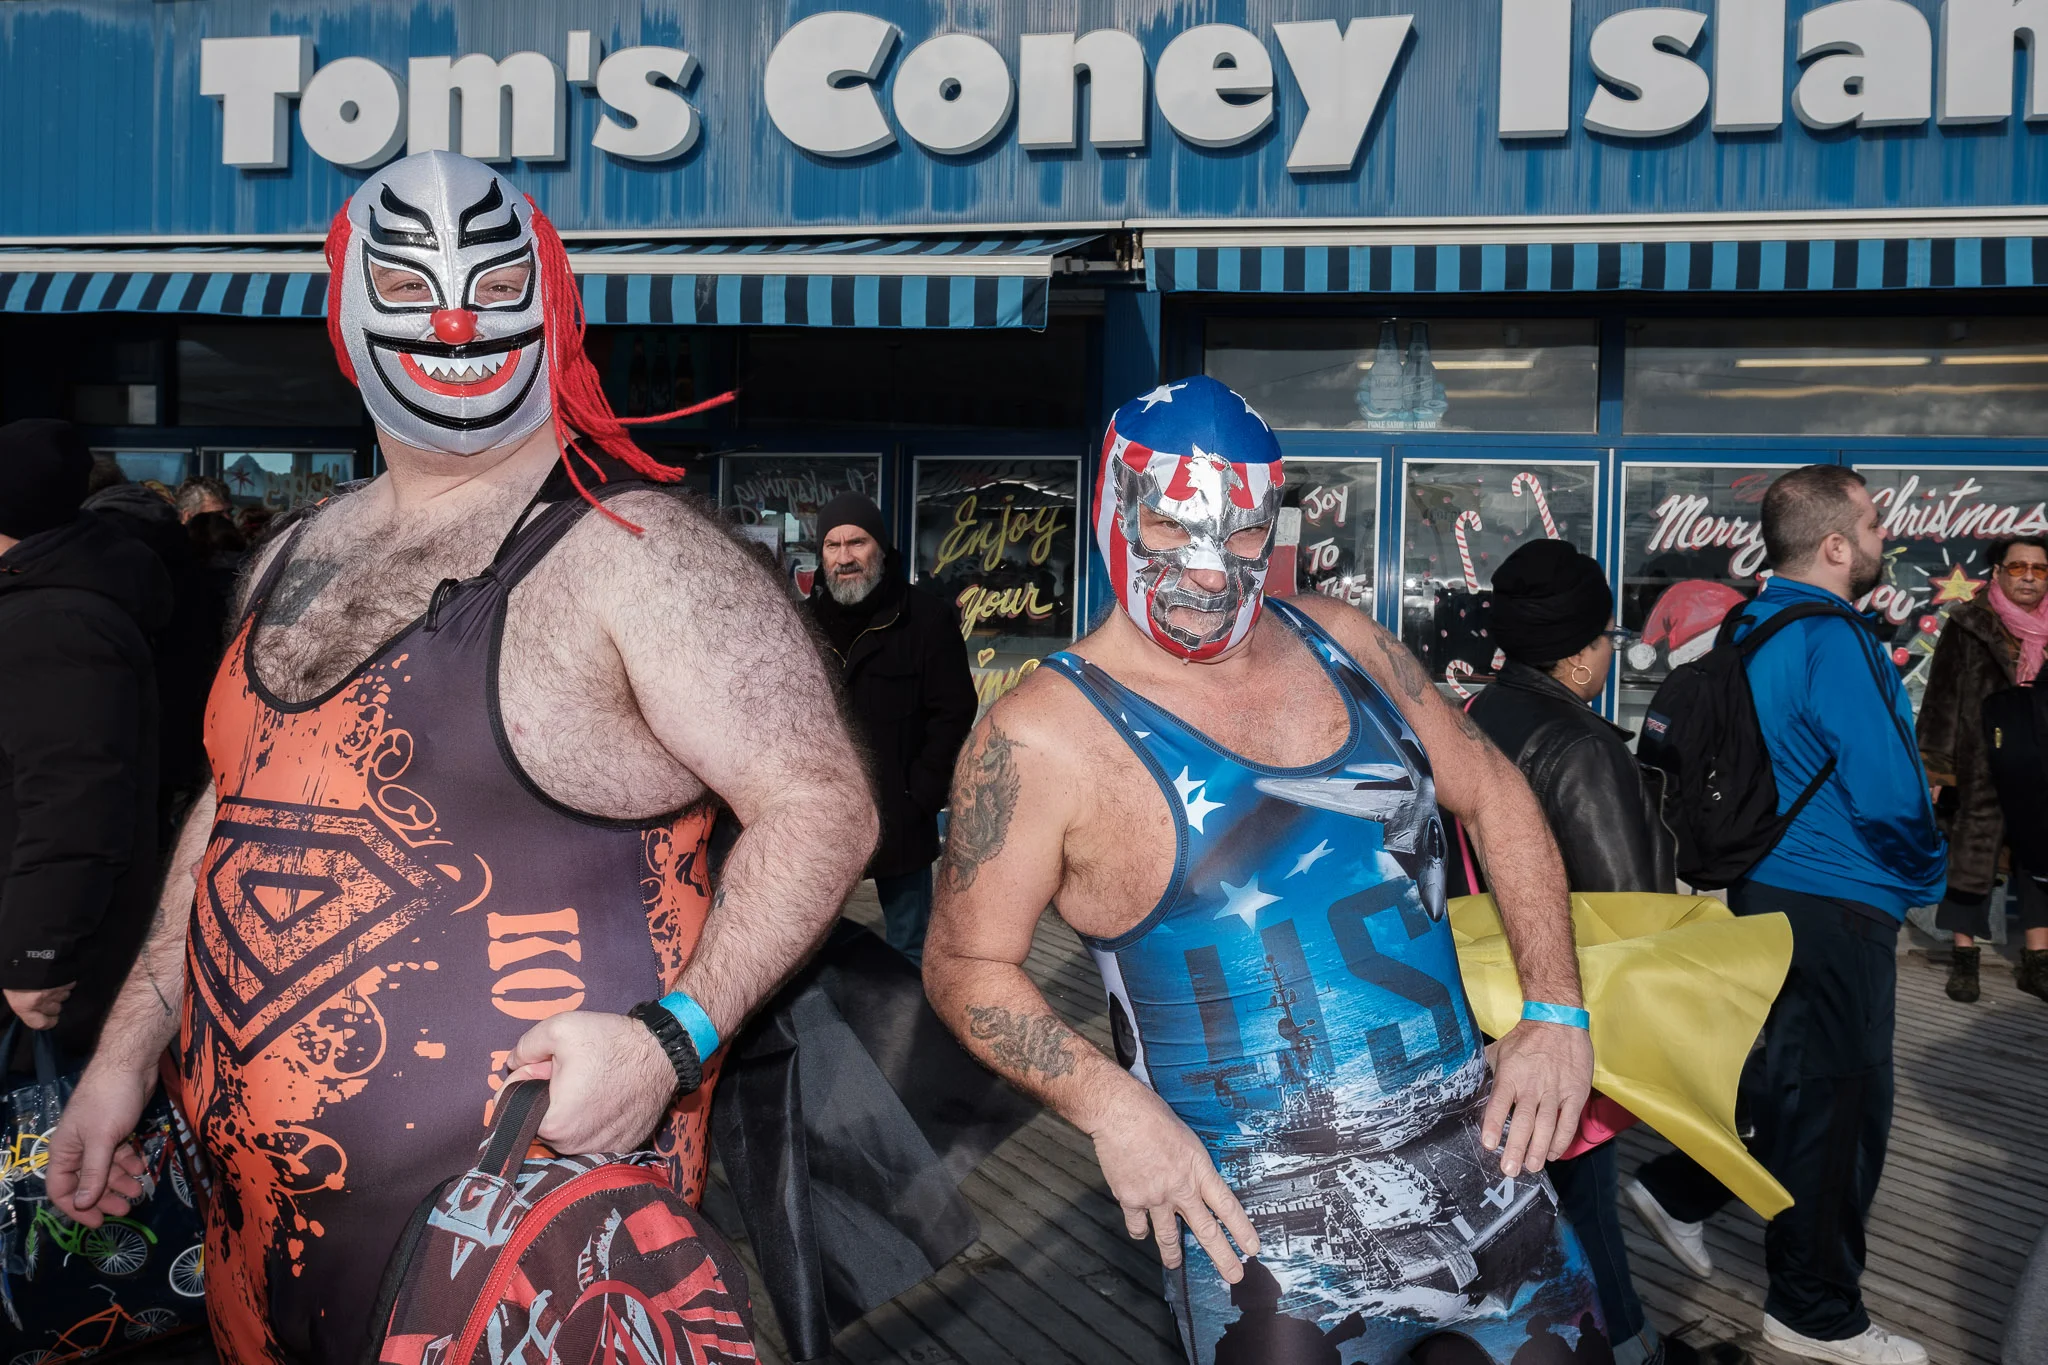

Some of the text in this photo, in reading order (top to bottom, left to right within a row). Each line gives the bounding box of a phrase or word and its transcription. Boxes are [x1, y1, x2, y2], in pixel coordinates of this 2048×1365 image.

[200, 30, 700, 169] Tom's
[764, 11, 1414, 173] Coney
[931, 494, 1067, 577] Enjoy
[1646, 494, 1768, 579] Merry
[957, 582, 1053, 641] your
